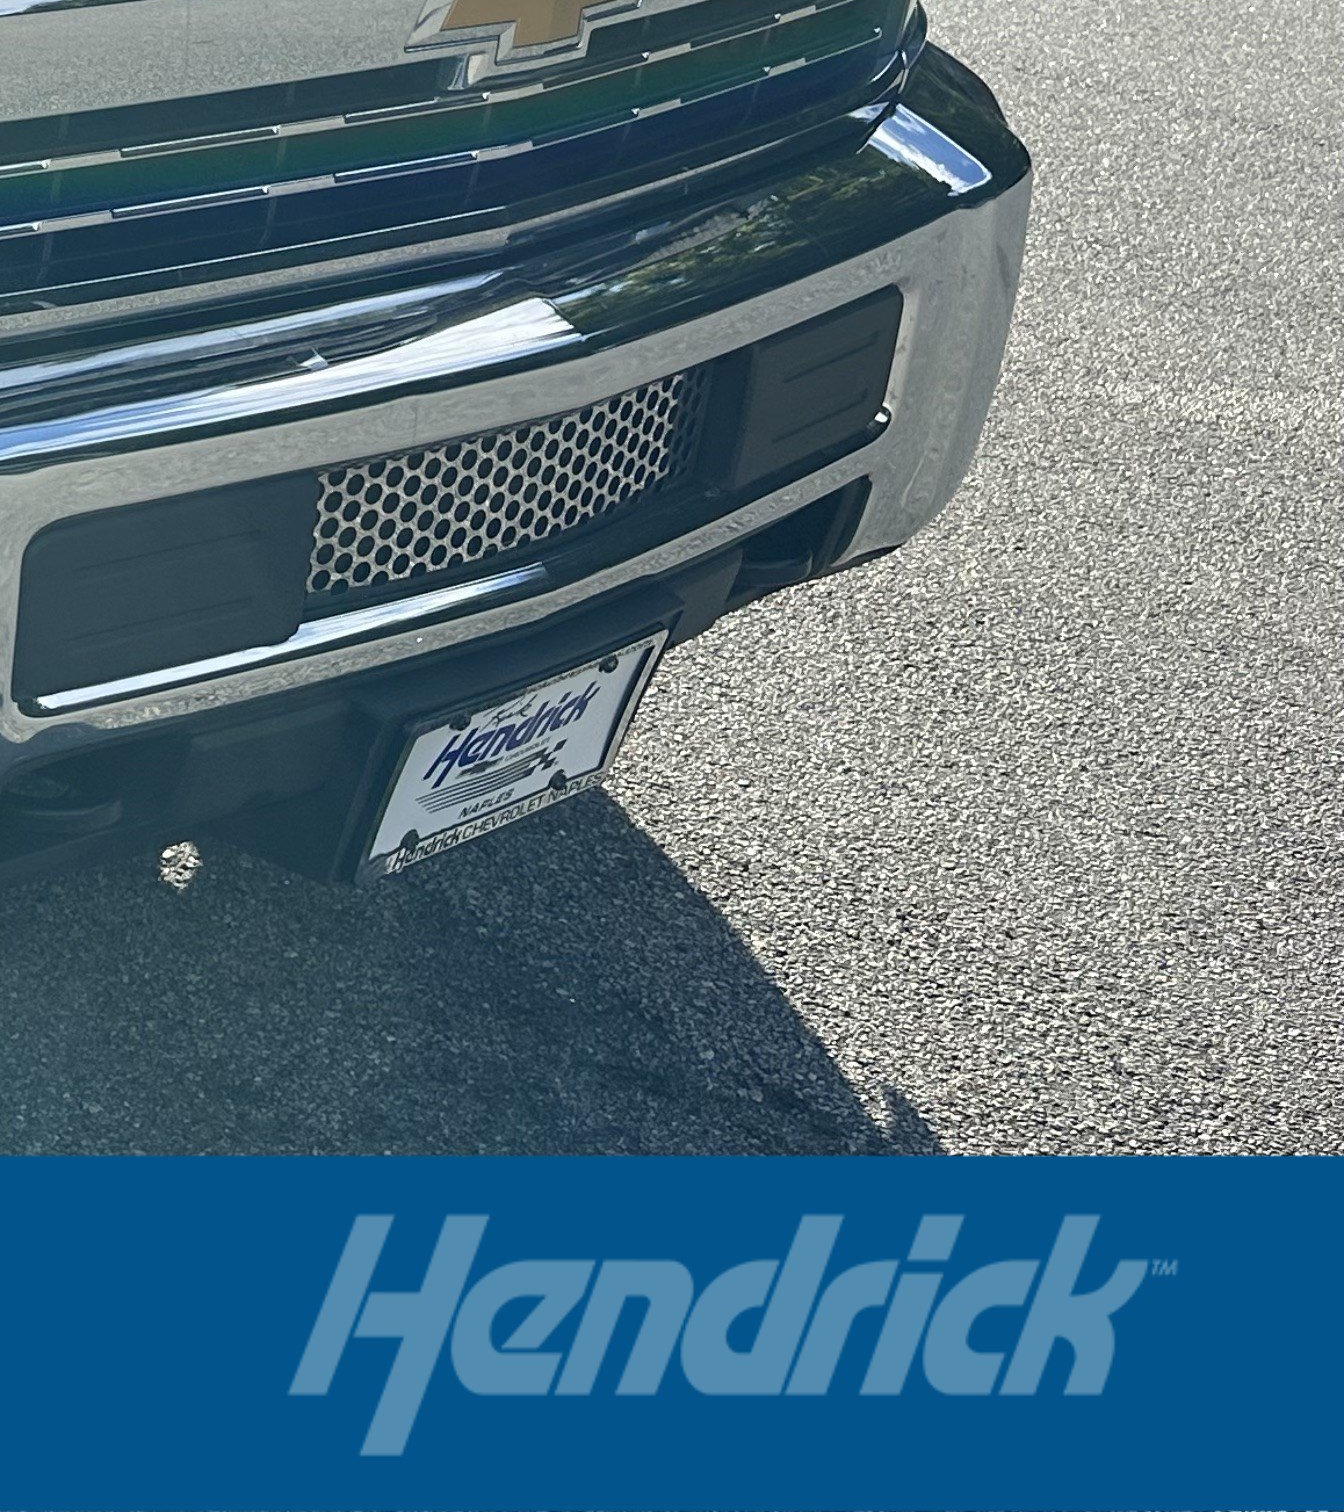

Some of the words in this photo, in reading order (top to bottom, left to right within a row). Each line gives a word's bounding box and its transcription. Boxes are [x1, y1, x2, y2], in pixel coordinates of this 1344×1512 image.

[422, 680, 601, 789] Hendrick
[457, 787, 515, 820] NAPLES
[462, 794, 545, 840] CHEVROLET
[545, 772, 604, 804] NAPLES
